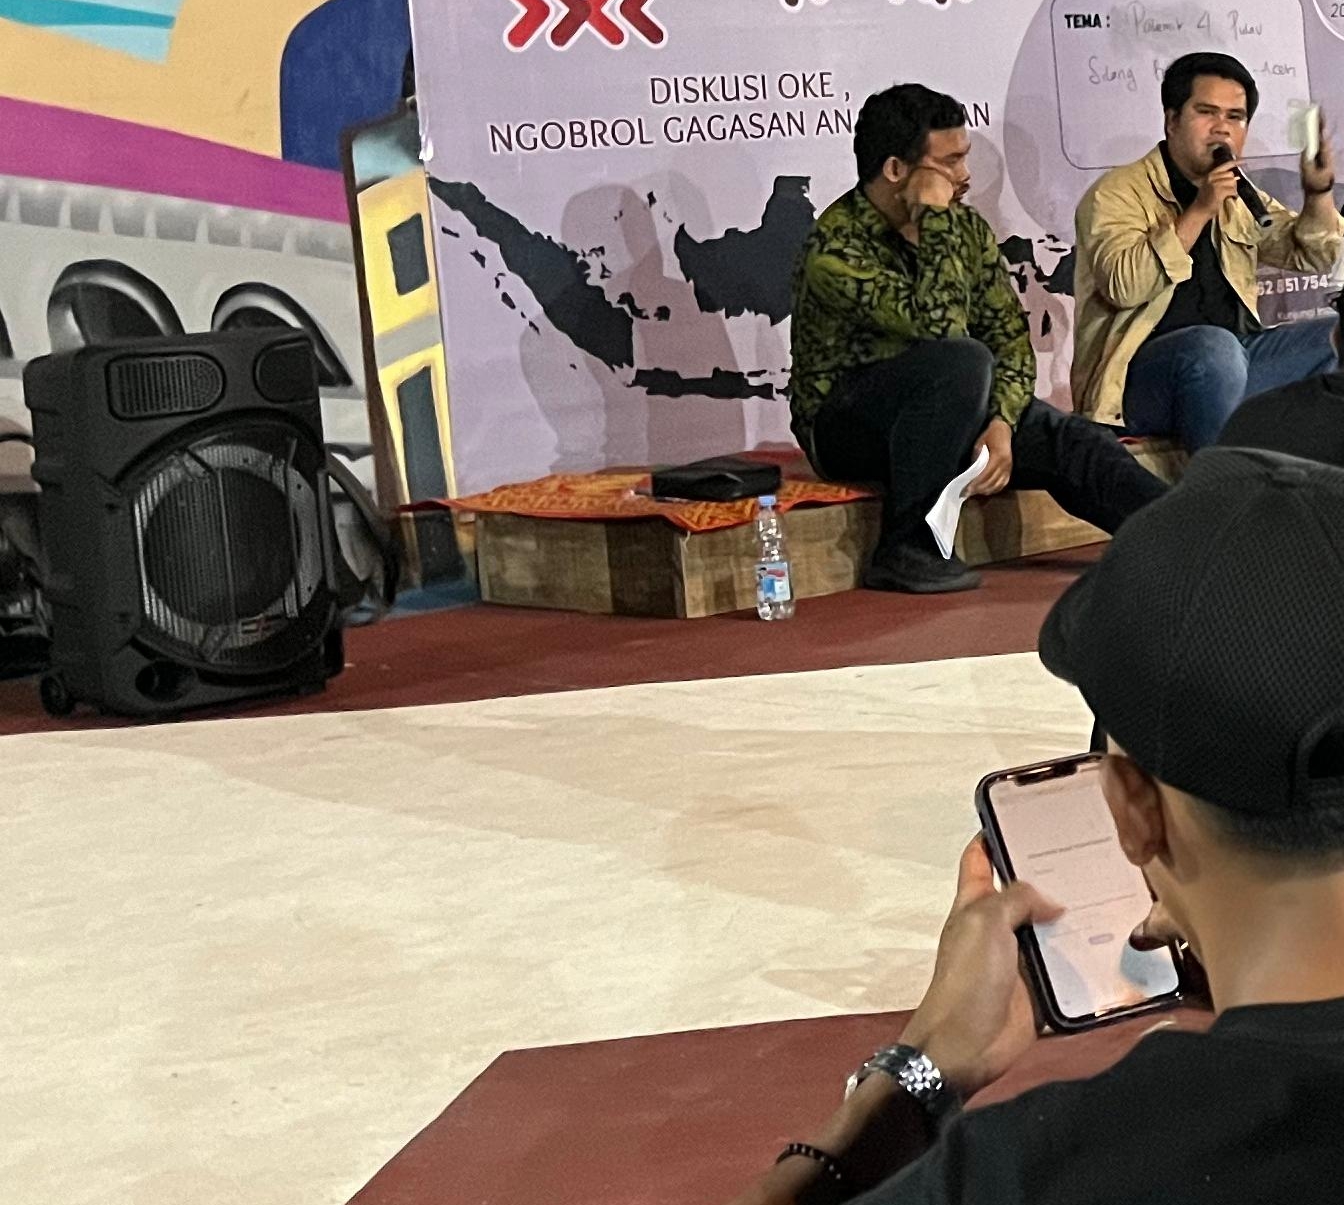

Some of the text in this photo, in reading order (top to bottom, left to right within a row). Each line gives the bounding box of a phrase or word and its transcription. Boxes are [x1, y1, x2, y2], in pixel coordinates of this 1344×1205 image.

[650, 74, 767, 105] DISKUSI
[778, 72, 835, 100] OKE
[489, 117, 654, 153] NGOBROL
[663, 111, 807, 144] GAGASAN
